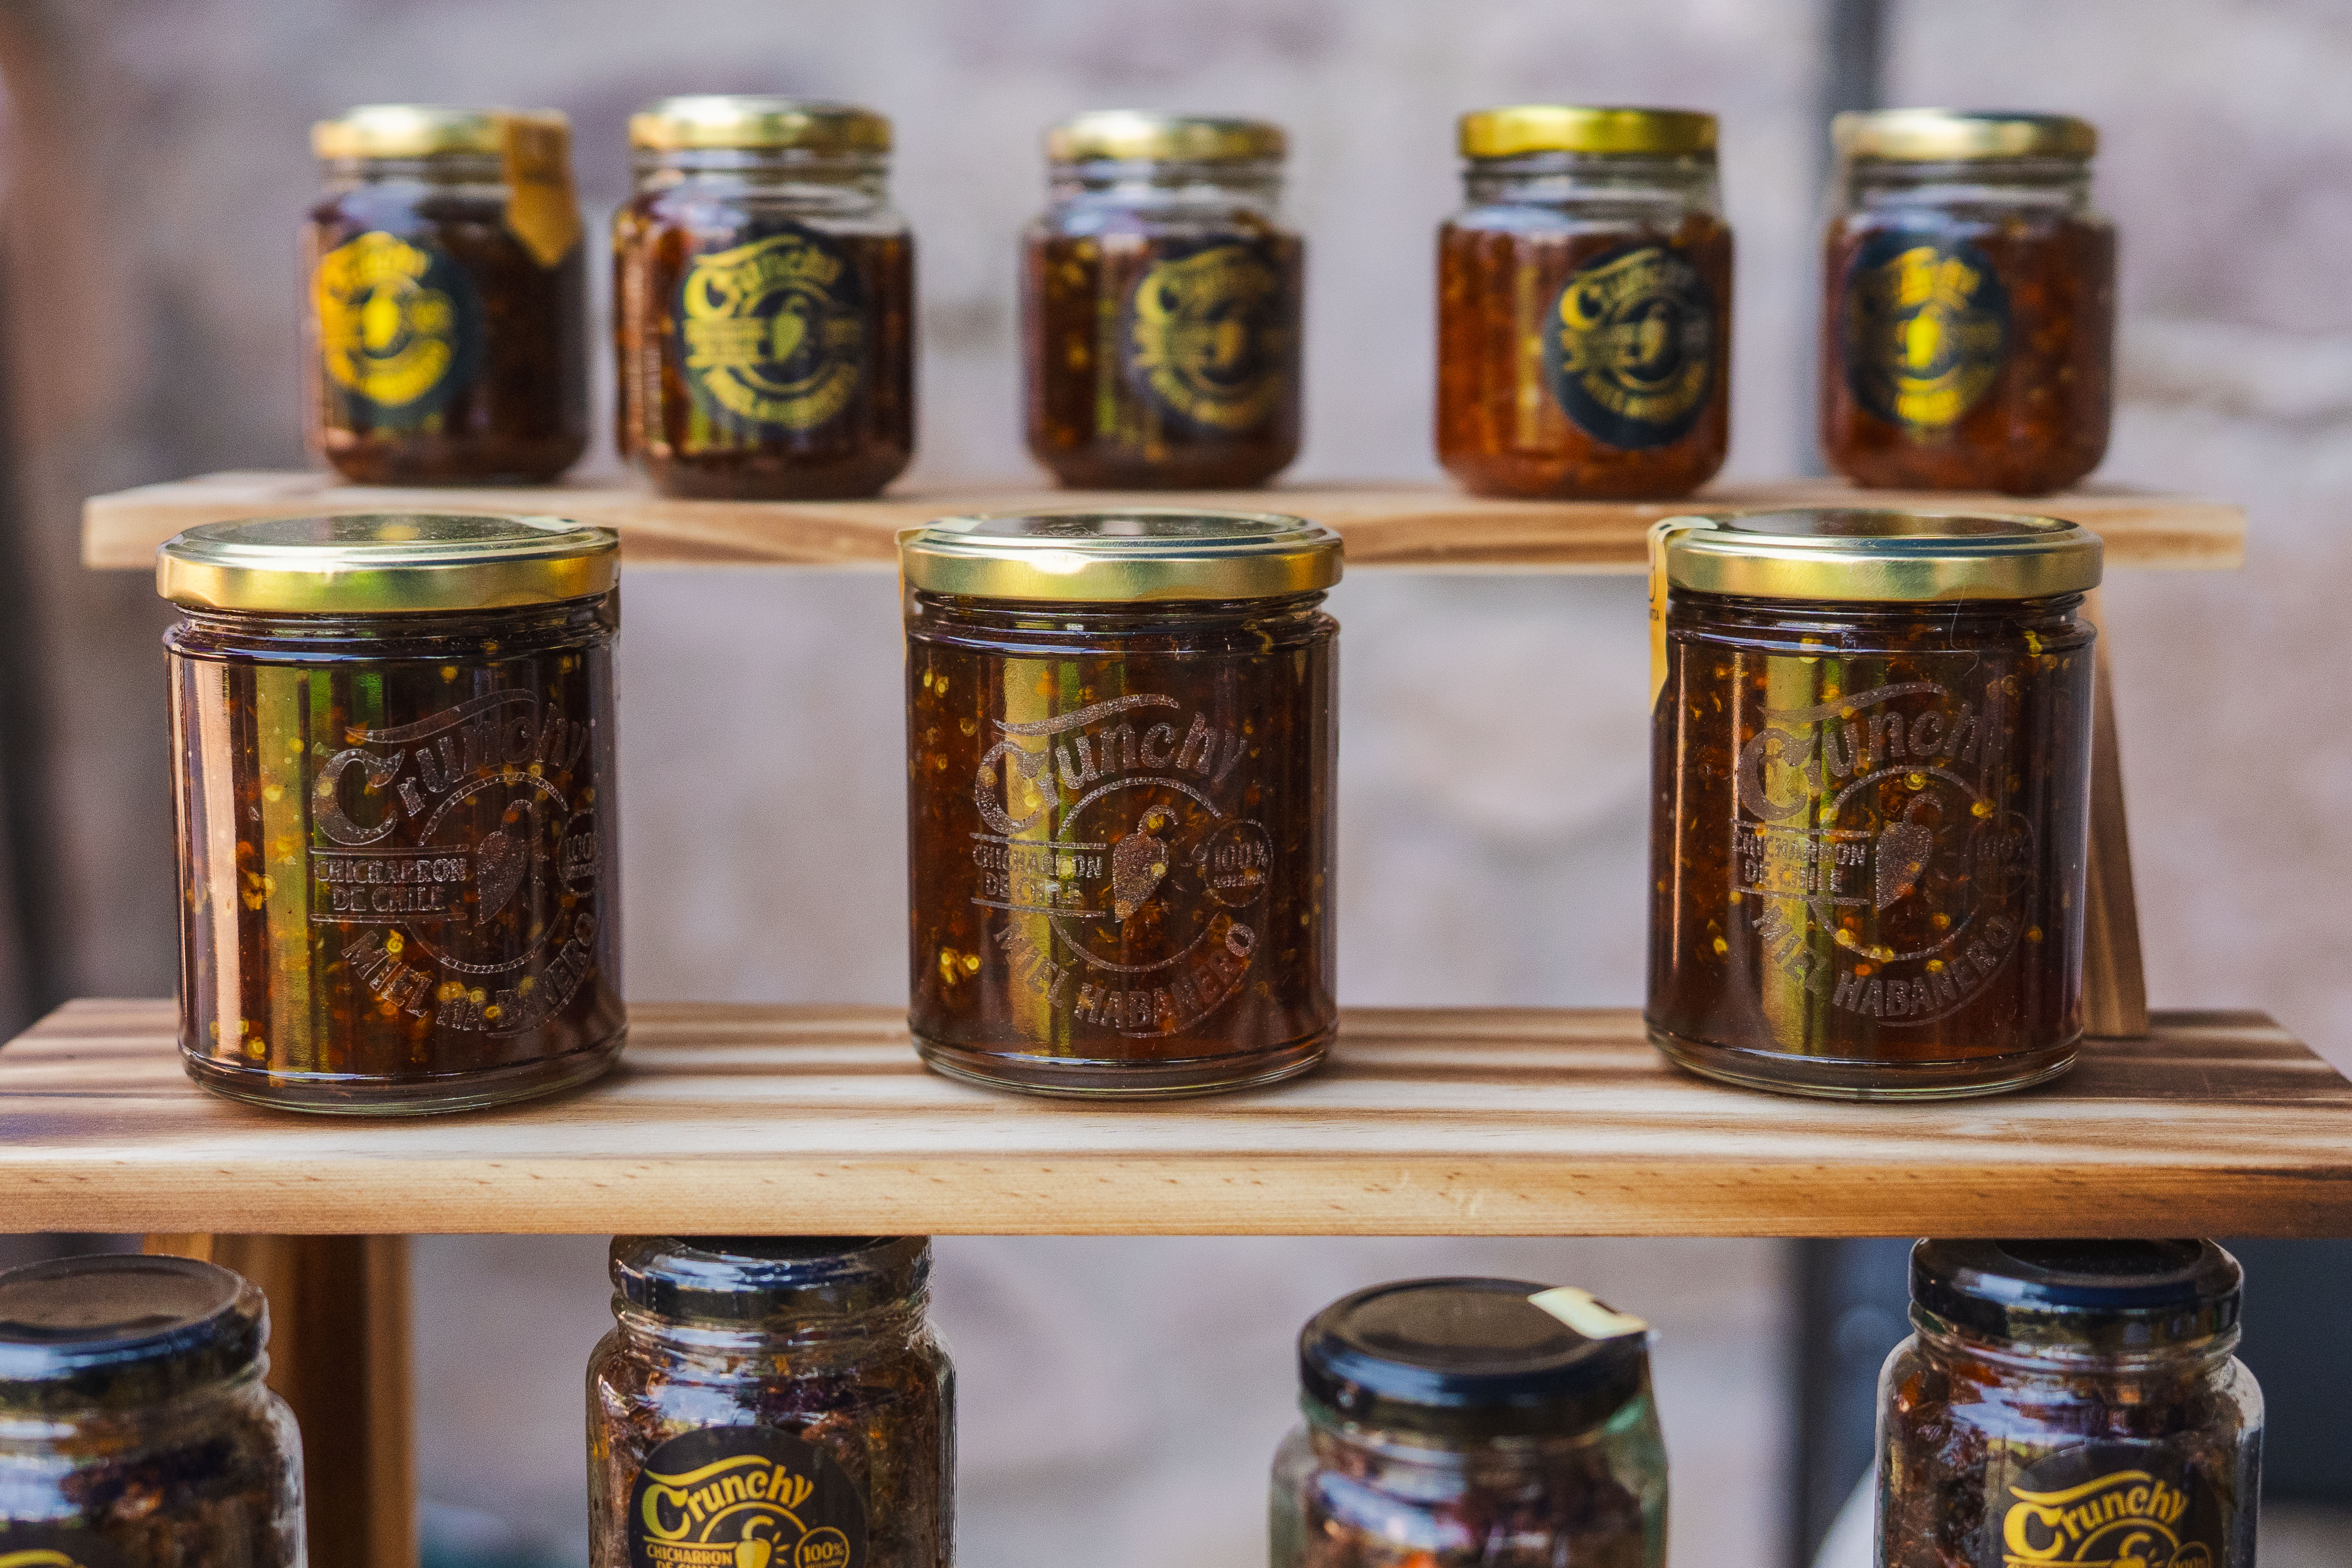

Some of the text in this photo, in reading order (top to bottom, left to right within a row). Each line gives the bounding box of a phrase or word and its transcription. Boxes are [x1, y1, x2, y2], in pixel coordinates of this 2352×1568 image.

[312, 689, 587, 846] Crunchy
[975, 694, 1247, 834] Crunchy
[986, 872, 1011, 898] DE
[1215, 841, 1268, 872] 100%
[1745, 859, 1771, 886] DE
[333, 886, 445, 912] DE CHILE
[1832, 914, 2014, 1017] HABANERO
[641, 1455, 814, 1540] Crunchy
[2003, 1470, 2189, 1559] Crunchy
[803, 1542, 845, 1563] 100%
